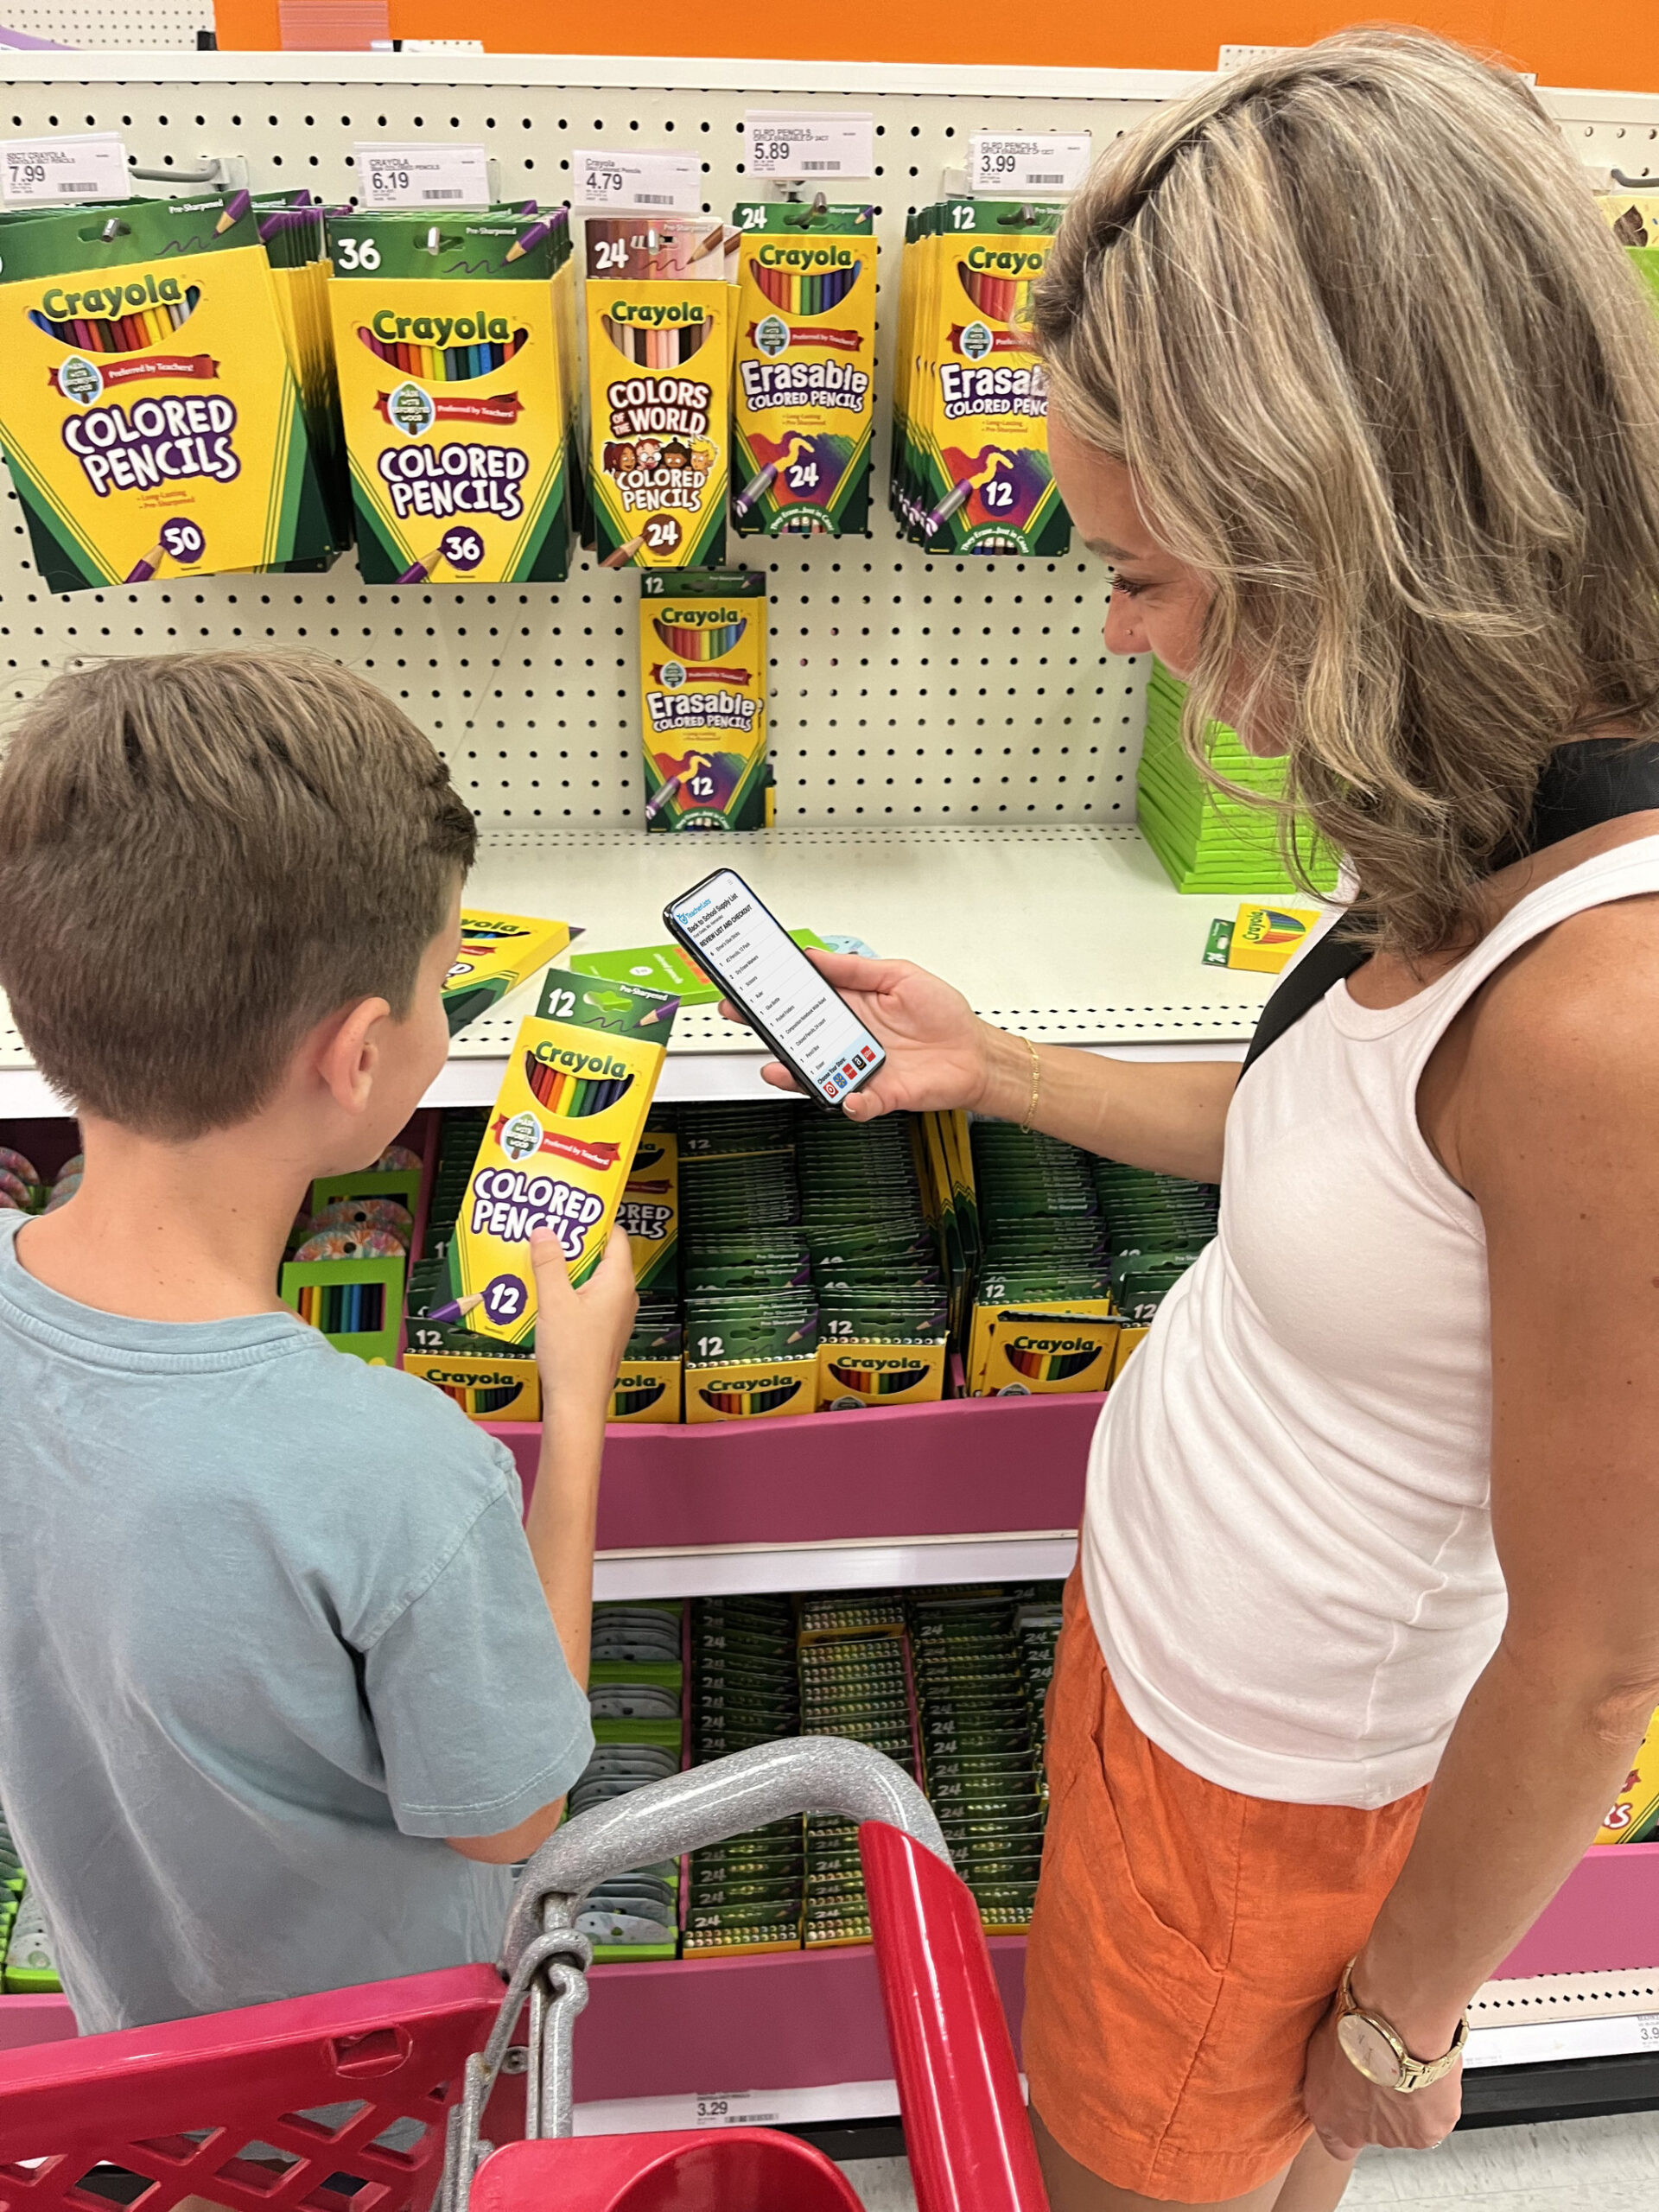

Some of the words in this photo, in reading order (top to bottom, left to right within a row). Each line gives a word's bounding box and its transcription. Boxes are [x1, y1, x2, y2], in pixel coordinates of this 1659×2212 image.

[754, 142, 791, 160] 5.89
[369, 158, 409, 167] CRAYOLA
[586, 158, 615, 168] Crayola
[981, 156, 1015, 173] 3.99
[9, 166, 46, 182] 7.99
[372, 172, 409, 189] 6.19
[586, 172, 623, 191] 4.79
[741, 205, 768, 229] 24
[951, 205, 976, 231] 12
[466, 226, 517, 237] Pre-Sharpened
[338, 238, 382, 270] 36
[594, 238, 630, 270] 24
[759, 244, 853, 270] Crayola
[42, 273, 181, 318] Crayola
[611, 300, 704, 326] Crayola
[372, 309, 510, 346] Crayola
[145, 364, 156, 373] by
[741, 359, 869, 396] Erasable
[940, 364, 1049, 402] Erasab
[608, 379, 710, 410] COLORS
[747, 391, 809, 411] COLORED
[810, 390, 864, 413] PENCILS
[944, 397, 1010, 419] COLORED
[1014, 397, 1048, 417] PENC
[65, 398, 234, 455] COLORED
[612, 412, 626, 424] OF
[628, 406, 707, 435] WORLD
[83, 436, 238, 494] PENCILS
[379, 446, 527, 482] COLORED
[617, 468, 706, 491] COLORED
[789, 461, 820, 489] 24
[391, 479, 522, 518] PENCILS
[622, 488, 702, 512] PENCILS
[986, 480, 1014, 507] 12
[164, 525, 202, 556] 50
[647, 520, 679, 547] 24
[445, 536, 481, 561] 36
[645, 576, 664, 594] 12
[661, 607, 739, 627] Crayola
[647, 690, 756, 720] Erasable
[653, 715, 705, 732] COLORED
[706, 715, 752, 732] PENCILS
[690, 777, 715, 796] 12
[685, 899, 711, 918] TeacherLists
[687, 922, 699, 932] Back
[702, 908, 717, 921] School
[715, 899, 732, 912] Supply
[728, 893, 738, 901] List
[461, 918, 519, 932] yola
[699, 933, 715, 947] REVIEW
[714, 926, 724, 936] LIST
[722, 919, 733, 929] AND
[731, 905, 753, 922] CHECKOUT
[1242, 911, 1266, 941] Crayola
[747, 955, 759, 964] Markers
[746, 976, 758, 986] Scissors
[620, 985, 669, 1001] Pre-Sharpened
[548, 988, 576, 1018] 12
[776, 1013, 785, 1021] Pocket
[785, 1004, 795, 1014] Folders
[785, 1019, 802, 1034] Composition
[796, 1035, 807, 1046] Colored
[536, 1040, 627, 1079] Crayola
[806, 1049, 815, 1058] Pencil
[816, 1060, 825, 1070] Eraser
[817, 1071, 830, 1084] Choose
[836, 1057, 846, 1067] Store:
[543, 1138, 573, 1152] Preferred
[572, 1146, 582, 1156] by
[689, 1139, 712, 1150] 12
[474, 1170, 603, 1225] COLORED
[490, 1283, 520, 1314] 12
[985, 1284, 1007, 1298] 12
[1134, 1304, 1157, 1319] 12
[827, 1319, 855, 1335] 12
[416, 1330, 444, 1346] 12
[697, 1337, 725, 1357] 12
[1013, 1335, 1095, 1353] Crayola
[836, 1356, 922, 1371] Crayola
[426, 1368, 515, 1386] Crayola
[707, 1375, 794, 1392] Crayola
[920, 1624, 944, 1637] 24
[703, 1635, 728, 1649] 24
[701, 1715, 726, 1729] 24
[931, 1721, 956, 1734] 24
[933, 1741, 957, 1754] 24
[938, 1783, 962, 1796] 24
[700, 1867, 727, 1882] 24
[694, 1915, 722, 1928] 24
[697, 2101, 728, 2116] 3.29
